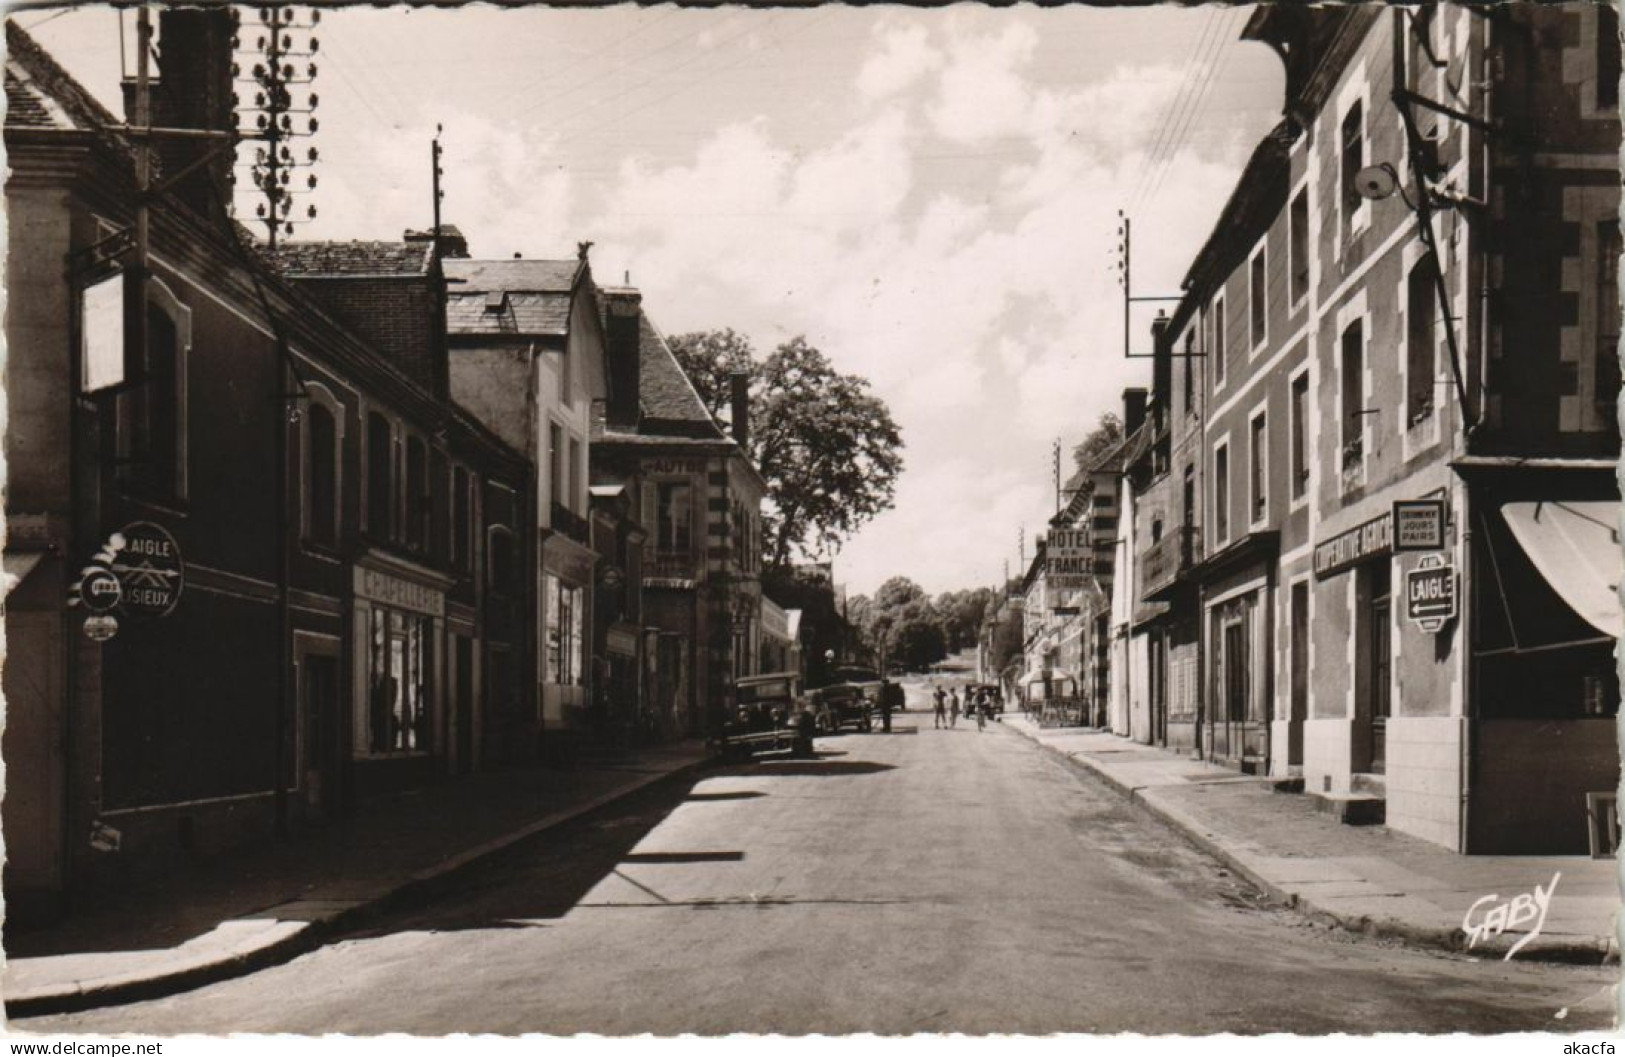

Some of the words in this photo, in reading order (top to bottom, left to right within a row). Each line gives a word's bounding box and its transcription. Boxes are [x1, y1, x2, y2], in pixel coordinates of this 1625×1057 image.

[1403, 520, 1435, 530] JOURS
[1047, 530, 1092, 548] HOTEL
[1402, 531, 1436, 541] PAIRS
[1047, 557, 1092, 574] FRANCE
